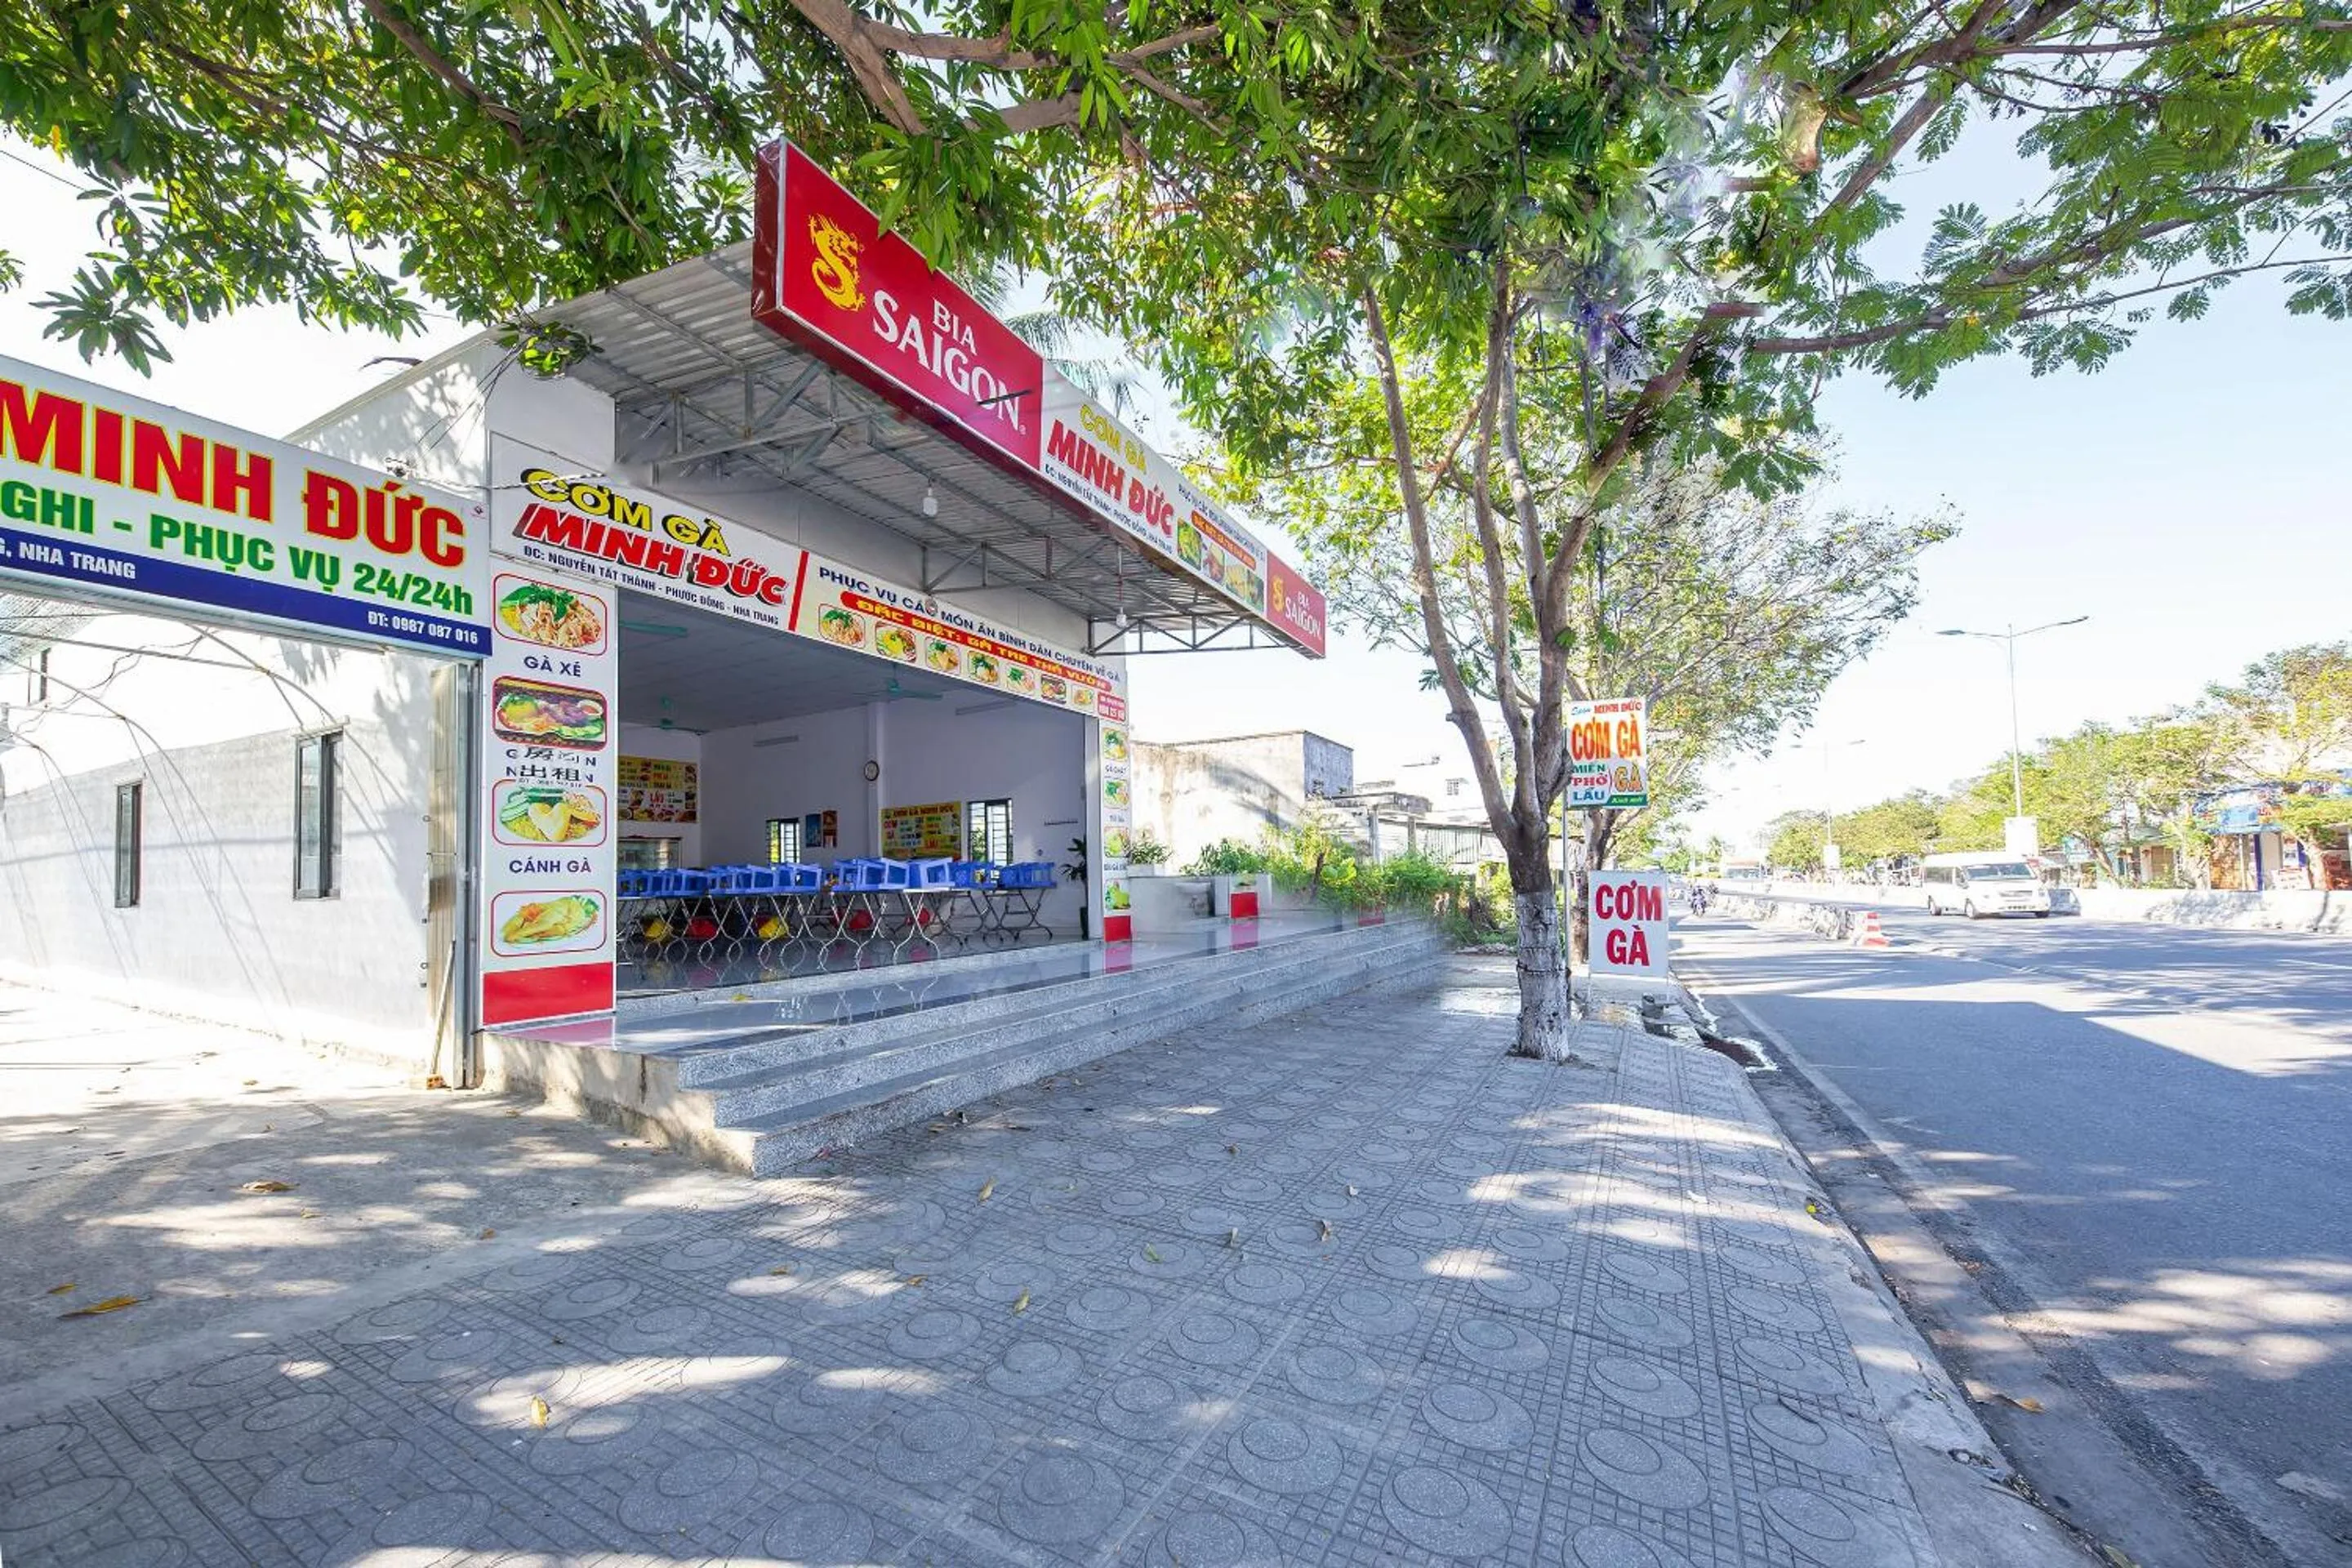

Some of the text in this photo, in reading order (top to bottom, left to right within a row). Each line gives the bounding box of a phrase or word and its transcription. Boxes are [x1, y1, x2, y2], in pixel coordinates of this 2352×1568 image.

[933, 298, 977, 356] BIA
[872, 289, 1022, 433] SAIGON
[0, 377, 466, 568] MINH ĐỨC
[1047, 418, 1125, 502] MINH
[1129, 476, 1174, 535] ĐỨC
[520, 468, 732, 556] CƠM GÀ
[19, 541, 65, 565] NHA
[70, 551, 136, 579] TRANG
[149, 513, 276, 572] PHỤC
[288, 546, 341, 591] VỤ
[354, 563, 473, 615] 24/24h
[513, 502, 788, 606] MINH ĐỨC
[819, 567, 871, 594] PHỤC
[875, 586, 897, 606] VỤ
[941, 611, 973, 630] MÓN
[1285, 596, 1322, 640] SAIGON
[368, 611, 478, 644] ĐT: 0987 087 016
[523, 656, 582, 677] GÀ XÉ
[1571, 714, 1641, 760] CƠM GÀ
[509, 853, 592, 875] CÁNH GÀ
[1595, 880, 1663, 921] CƠM
[1606, 924, 1650, 967] GÀ
